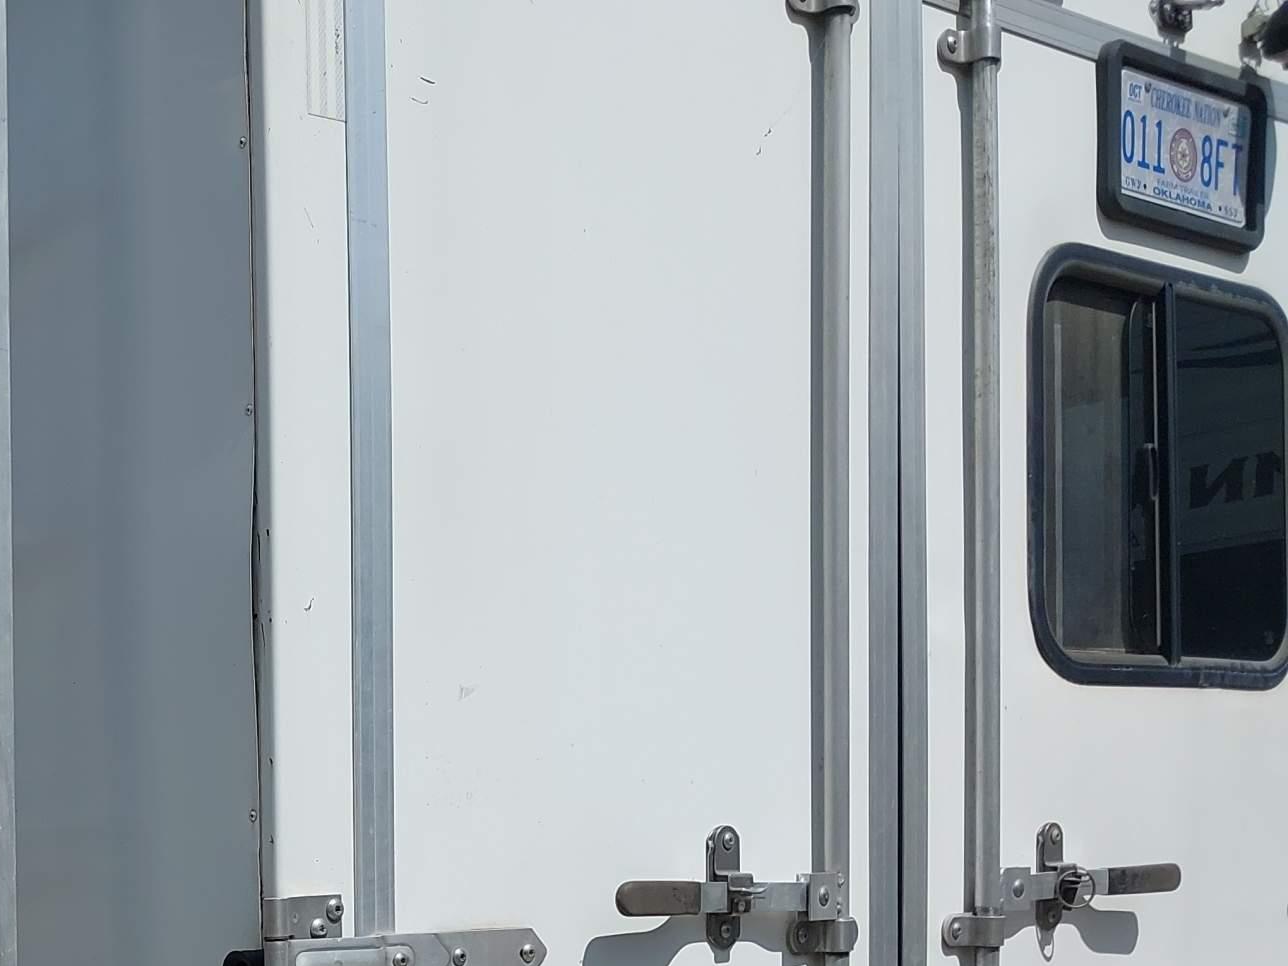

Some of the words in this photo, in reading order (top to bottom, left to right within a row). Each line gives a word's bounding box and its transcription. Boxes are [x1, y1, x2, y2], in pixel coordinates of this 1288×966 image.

[1122, 110, 1165, 174] 011
[1200, 135, 1244, 196] 8FT
[1153, 187, 1212, 211] OKLAHOMA
